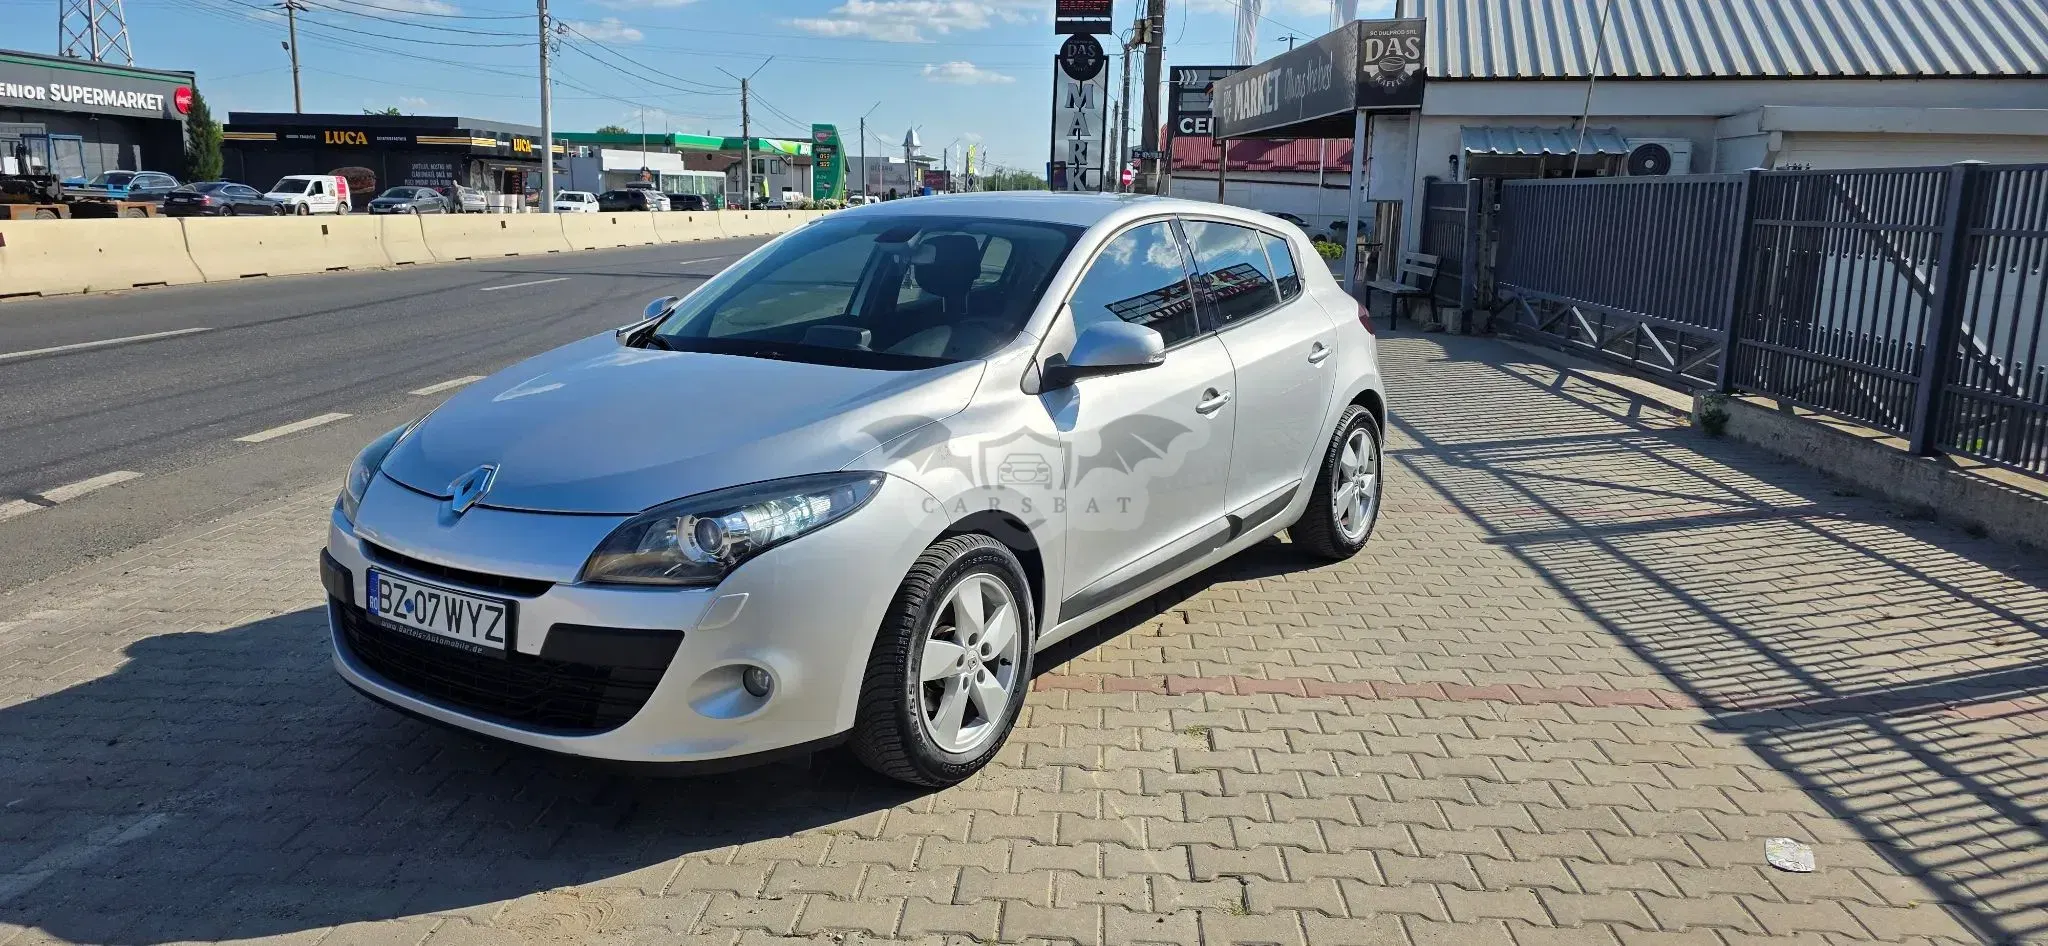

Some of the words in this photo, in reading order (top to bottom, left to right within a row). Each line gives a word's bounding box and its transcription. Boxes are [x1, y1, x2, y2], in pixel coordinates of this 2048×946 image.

[1067, 44, 1096, 58] DAS
[1365, 37, 1421, 63] DAS
[49, 83, 164, 111] SUPERMARKET
[1234, 68, 1282, 122] MARKET
[325, 131, 368, 145] LUCA
[512, 138, 532, 153] LUCA
[369, 595, 378, 611] RO
